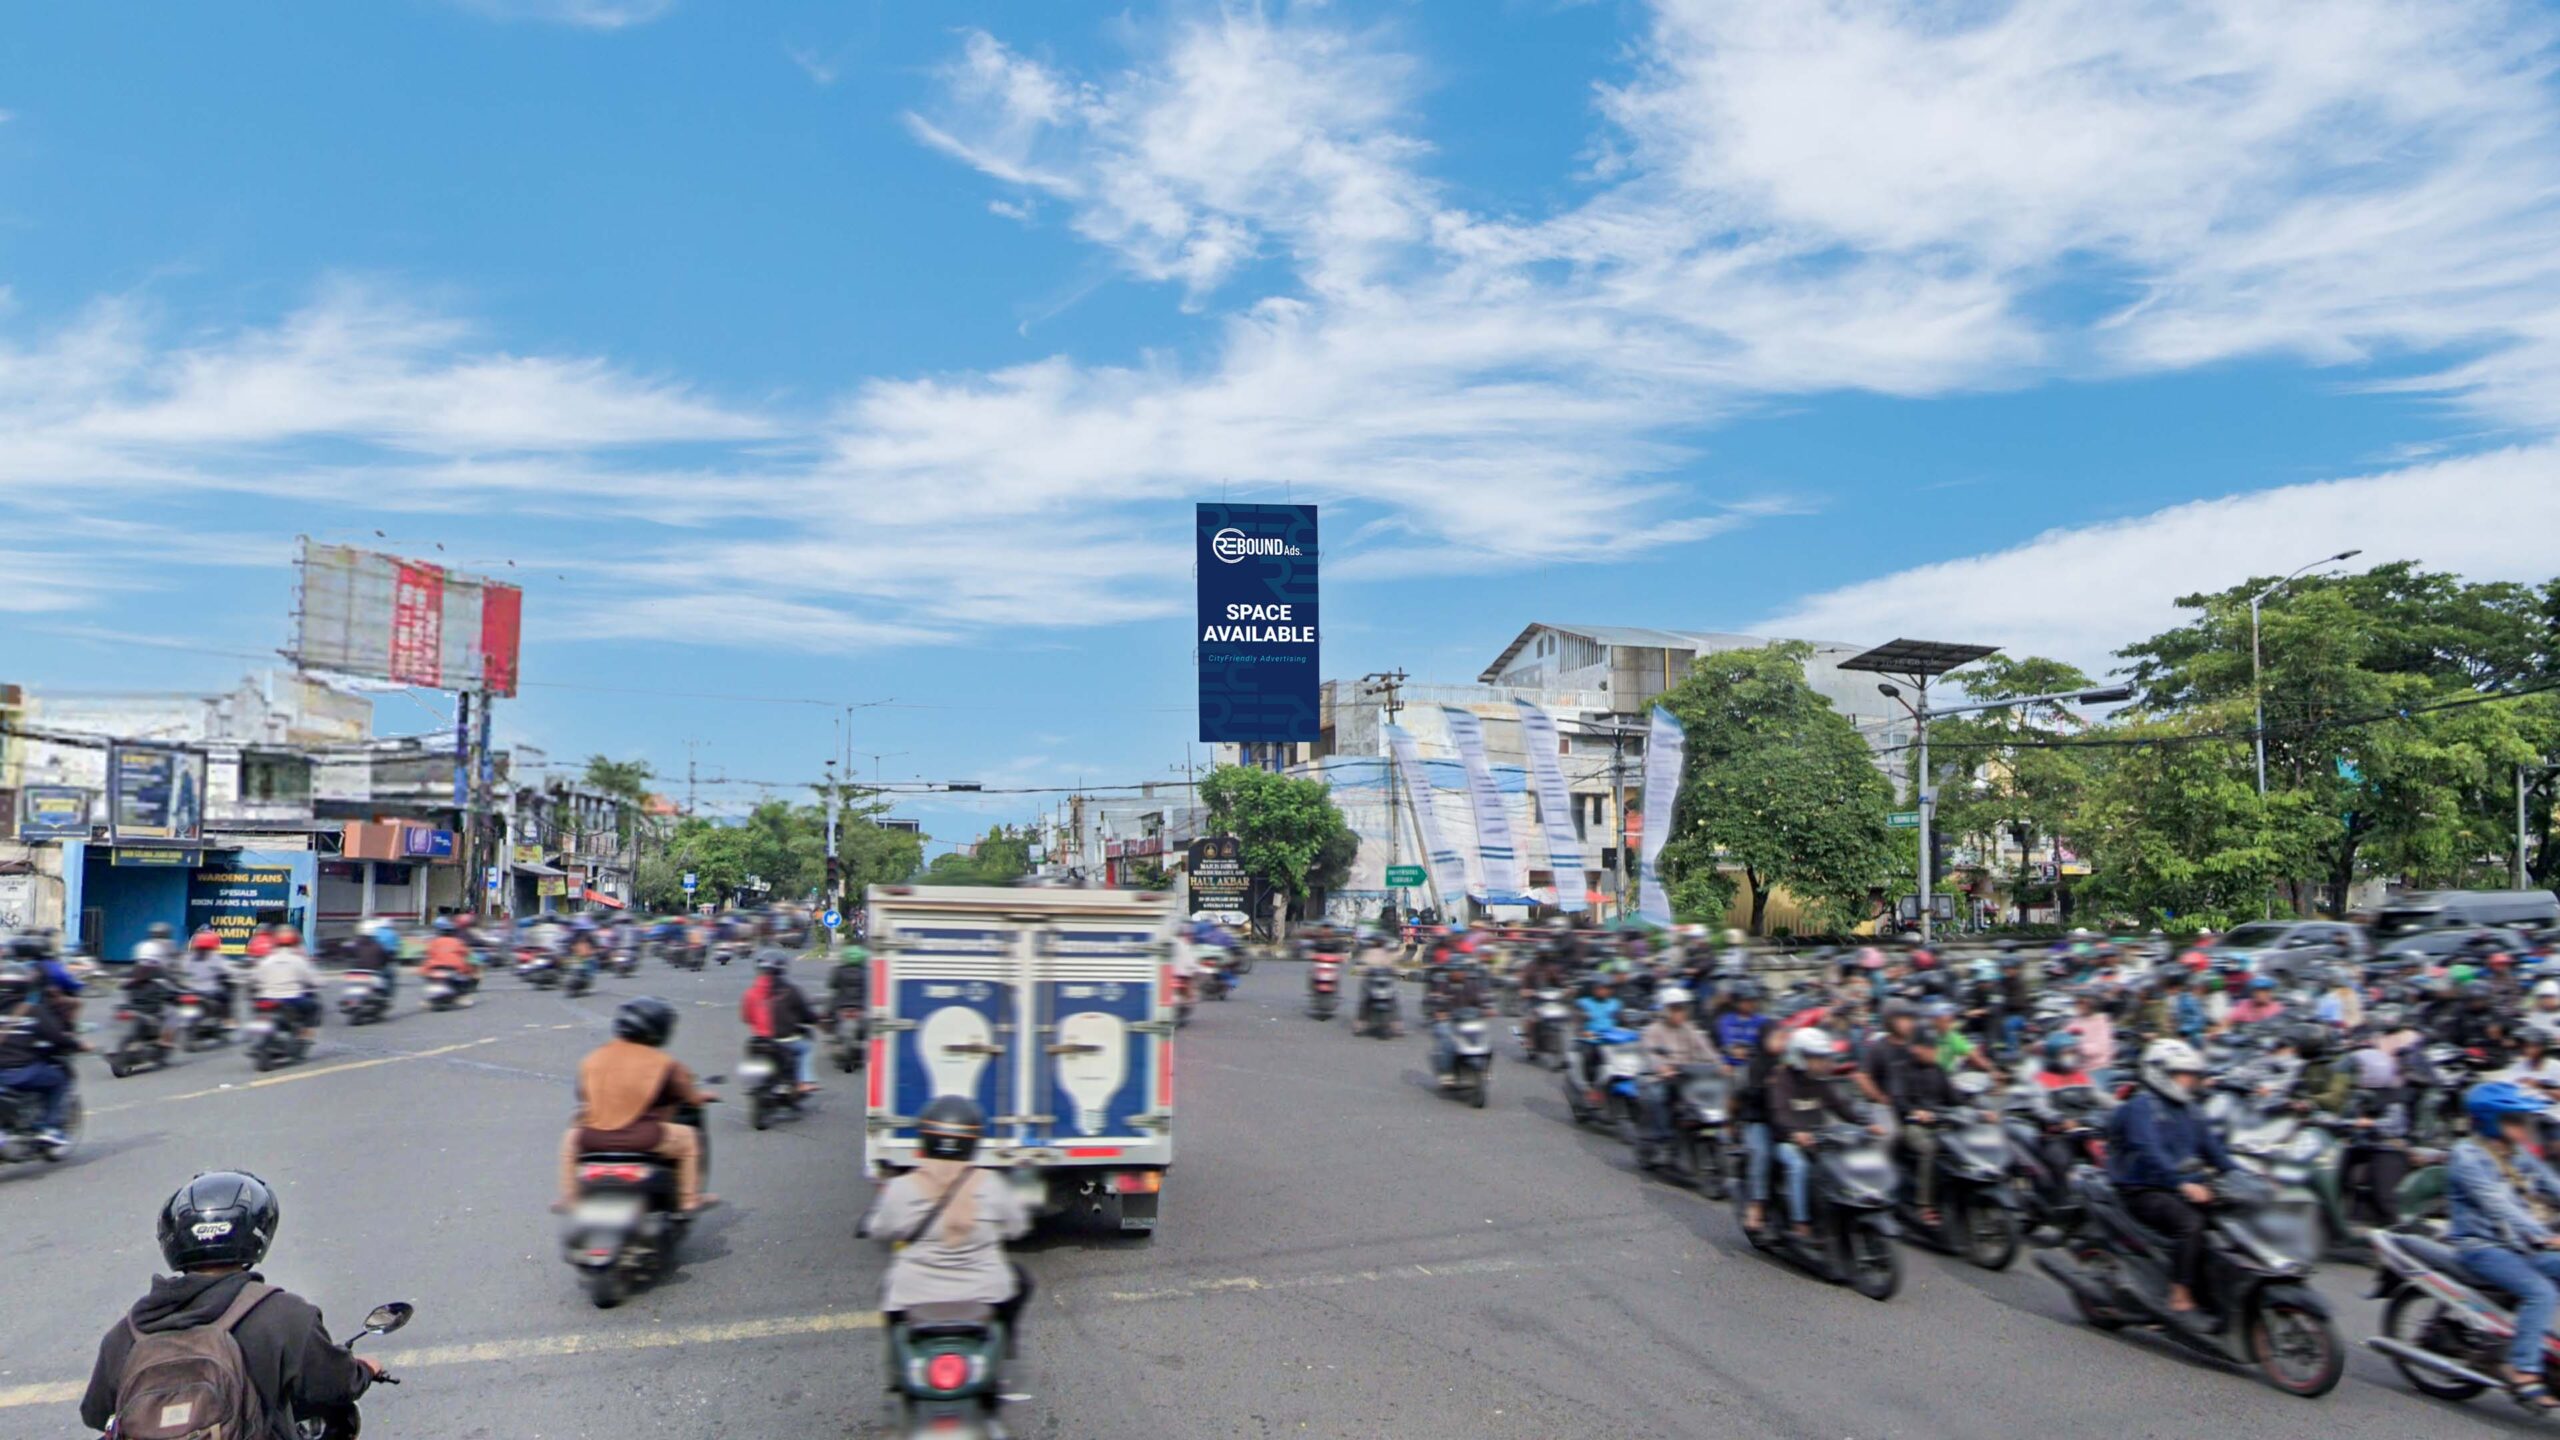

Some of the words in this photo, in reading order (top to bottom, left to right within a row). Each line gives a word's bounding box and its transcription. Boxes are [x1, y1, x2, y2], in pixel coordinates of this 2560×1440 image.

[1213, 533, 1283, 559] REBOUND
[1284, 545, 1302, 556] Ads.
[1227, 604, 1291, 620] SPACE
[1203, 625, 1314, 642] AVAILABLE
[1208, 654, 1257, 664] CityFriendly
[1260, 655, 1307, 664] Advertising
[251, 873, 283, 883] JEANS
[1190, 876, 1214, 886] HAUL
[1216, 876, 1250, 886] AKBAR
[219, 889, 258, 897] SPESIALIS
[215, 899, 240, 907] JEANS
[242, 899, 248, 907] &
[250, 899, 284, 907] VERMAK
[211, 915, 257, 926] UKURA
[214, 928, 249, 938] AMIN
